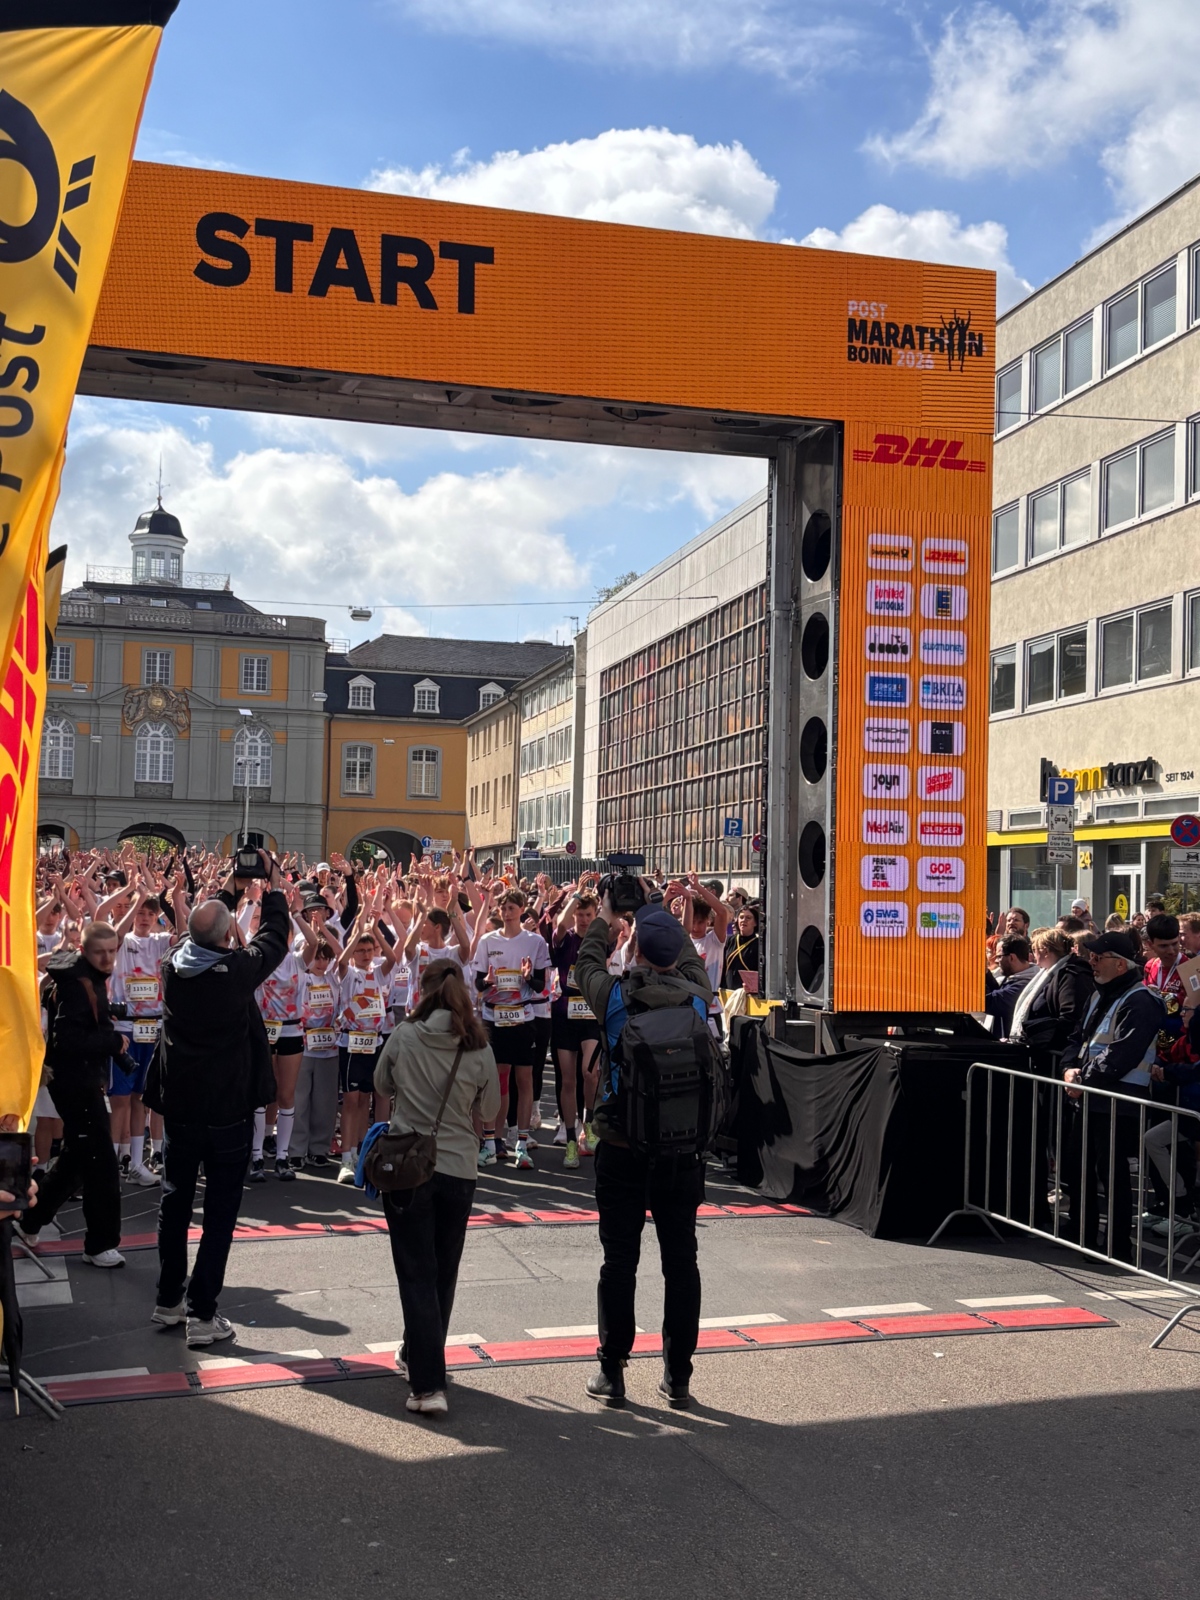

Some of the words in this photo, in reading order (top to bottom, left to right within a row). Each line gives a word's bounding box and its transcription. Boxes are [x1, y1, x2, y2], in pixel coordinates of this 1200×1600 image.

[193, 211, 495, 315] START
[848, 300, 888, 319] POST
[847, 318, 983, 357] MARATHN
[847, 345, 892, 365] BONN
[871, 433, 969, 471] DHL
[932, 682, 964, 697] BRITA
[1107, 756, 1156, 788] tanzt
[1165, 773, 1178, 782] SEIT
[1180, 771, 1194, 781] 1924
[873, 773, 900, 791] joyn
[1054, 781, 1069, 801] P
[728, 820, 739, 834] P
[1079, 851, 1091, 868] 24
[876, 909, 899, 918] SWB
[499, 1011, 520, 1019] 1308
[312, 1034, 332, 1043] 1156
[354, 1037, 373, 1046] 1303
